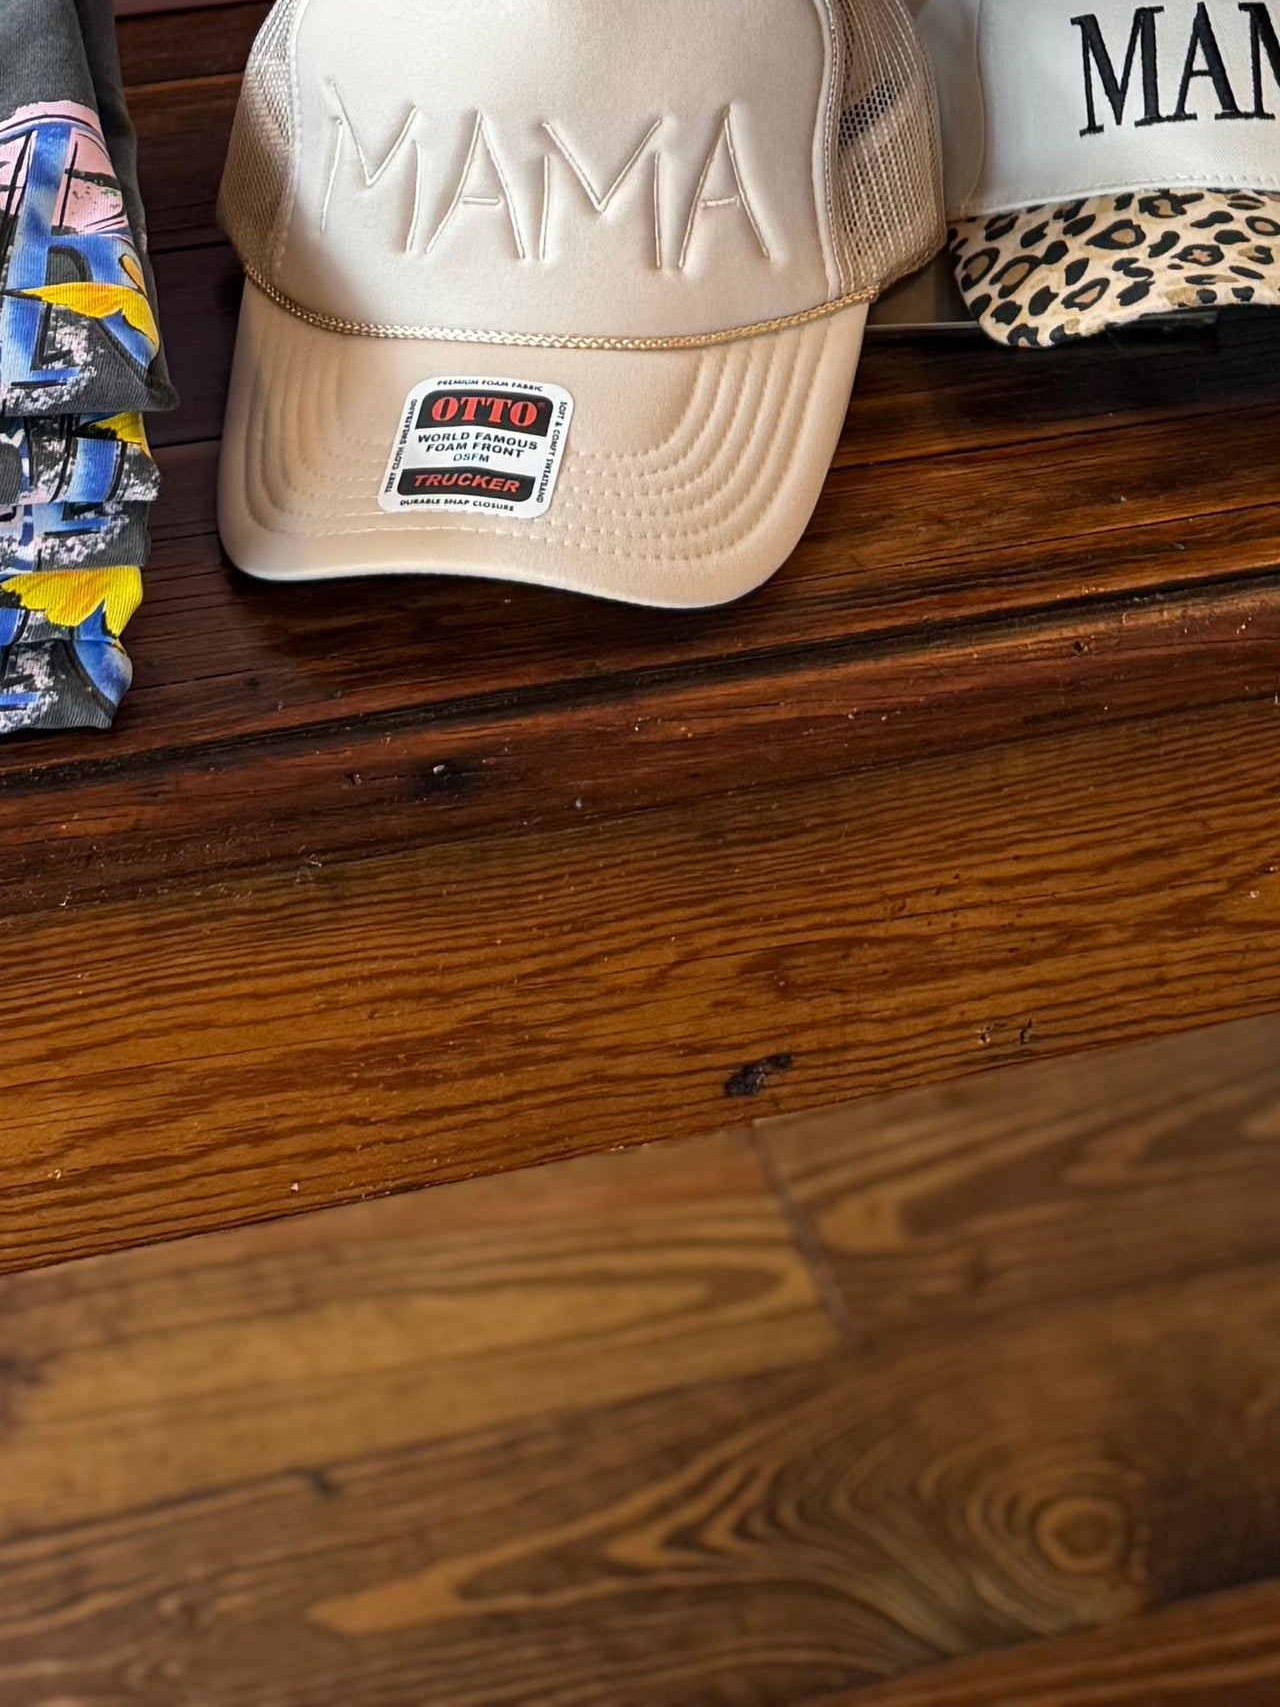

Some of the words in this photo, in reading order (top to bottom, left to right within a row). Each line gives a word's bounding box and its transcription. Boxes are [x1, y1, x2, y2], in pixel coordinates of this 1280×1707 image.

[318, 75, 776, 275] MAMA
[437, 378, 479, 386] PREMIUM
[482, 379, 509, 387] FOAM
[512, 383, 544, 392] FABRIC
[432, 396, 538, 427] OTTO
[418, 432, 470, 444] WORLD
[476, 433, 538, 450] FAMOUS
[426, 442, 468, 453] FOAM
[473, 443, 525, 459] FRONT
[453, 453, 490, 463] OSFM
[414, 474, 521, 493] TRUCKER
[401, 498, 441, 506] DURABLE
[473, 501, 516, 512] CLOSURE
